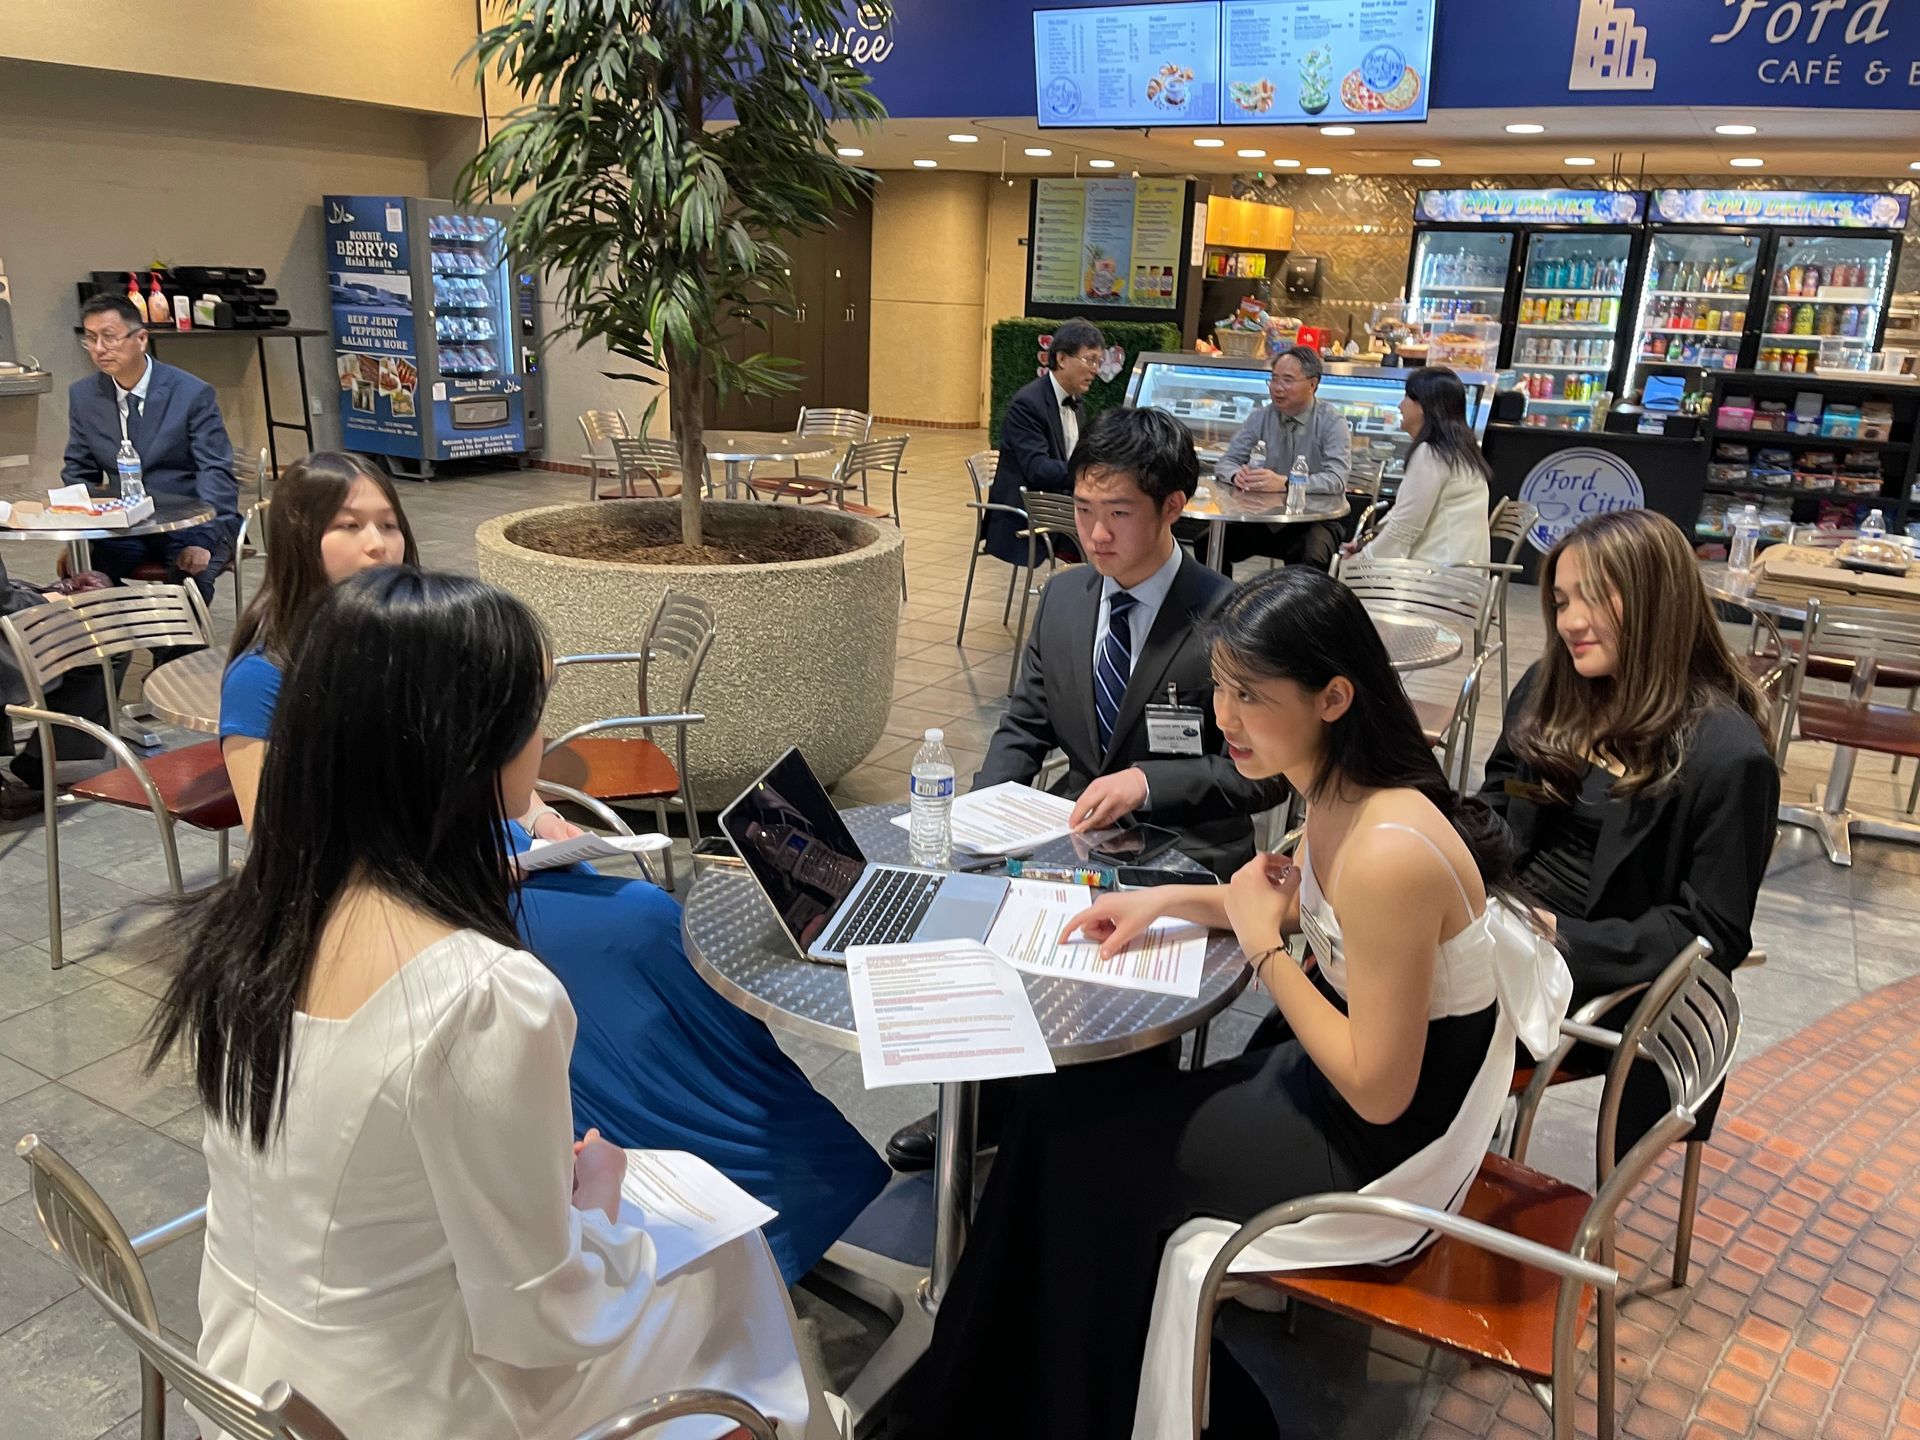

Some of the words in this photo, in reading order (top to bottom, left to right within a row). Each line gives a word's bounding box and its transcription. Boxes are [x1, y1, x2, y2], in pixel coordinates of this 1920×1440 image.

[1758, 54, 1842, 85] CAFÉ
[1864, 60, 1891, 85] &
[1461, 198, 1514, 215] COLD
[1516, 198, 1596, 216] DRINKS
[1701, 198, 1763, 217] COLD
[1764, 199, 1855, 218] DRINKS
[349, 230, 382, 241] RONNIE
[335, 240, 399, 258] BERRY'S
[347, 314, 369, 325] BEEF
[370, 316, 398, 328] JERKY
[351, 326, 398, 338] PEPPERONI
[383, 338, 409, 350] MORE
[1541, 468, 1602, 493] Ford
